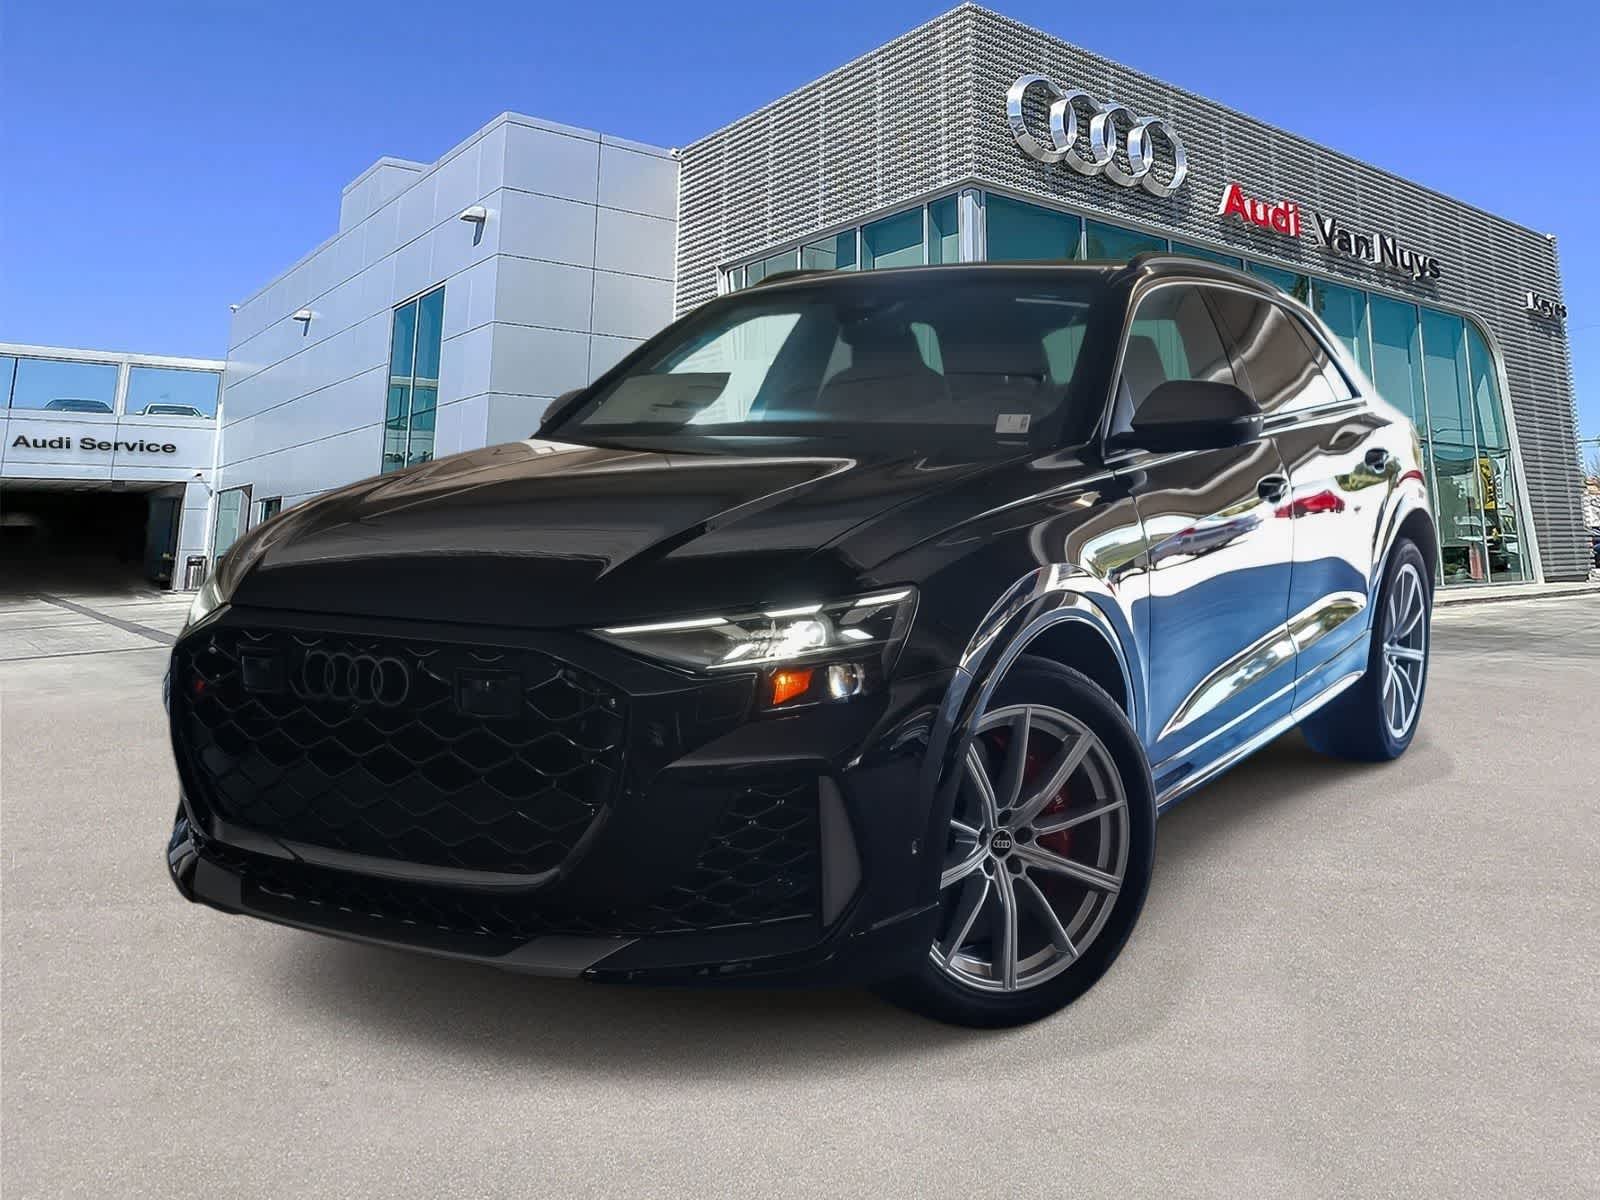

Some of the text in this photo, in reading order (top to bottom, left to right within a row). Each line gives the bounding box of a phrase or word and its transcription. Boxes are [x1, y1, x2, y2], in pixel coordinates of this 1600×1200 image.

[1220, 183, 1441, 280] Audi Van Nuys
[12, 434, 178, 454] Audi Service
